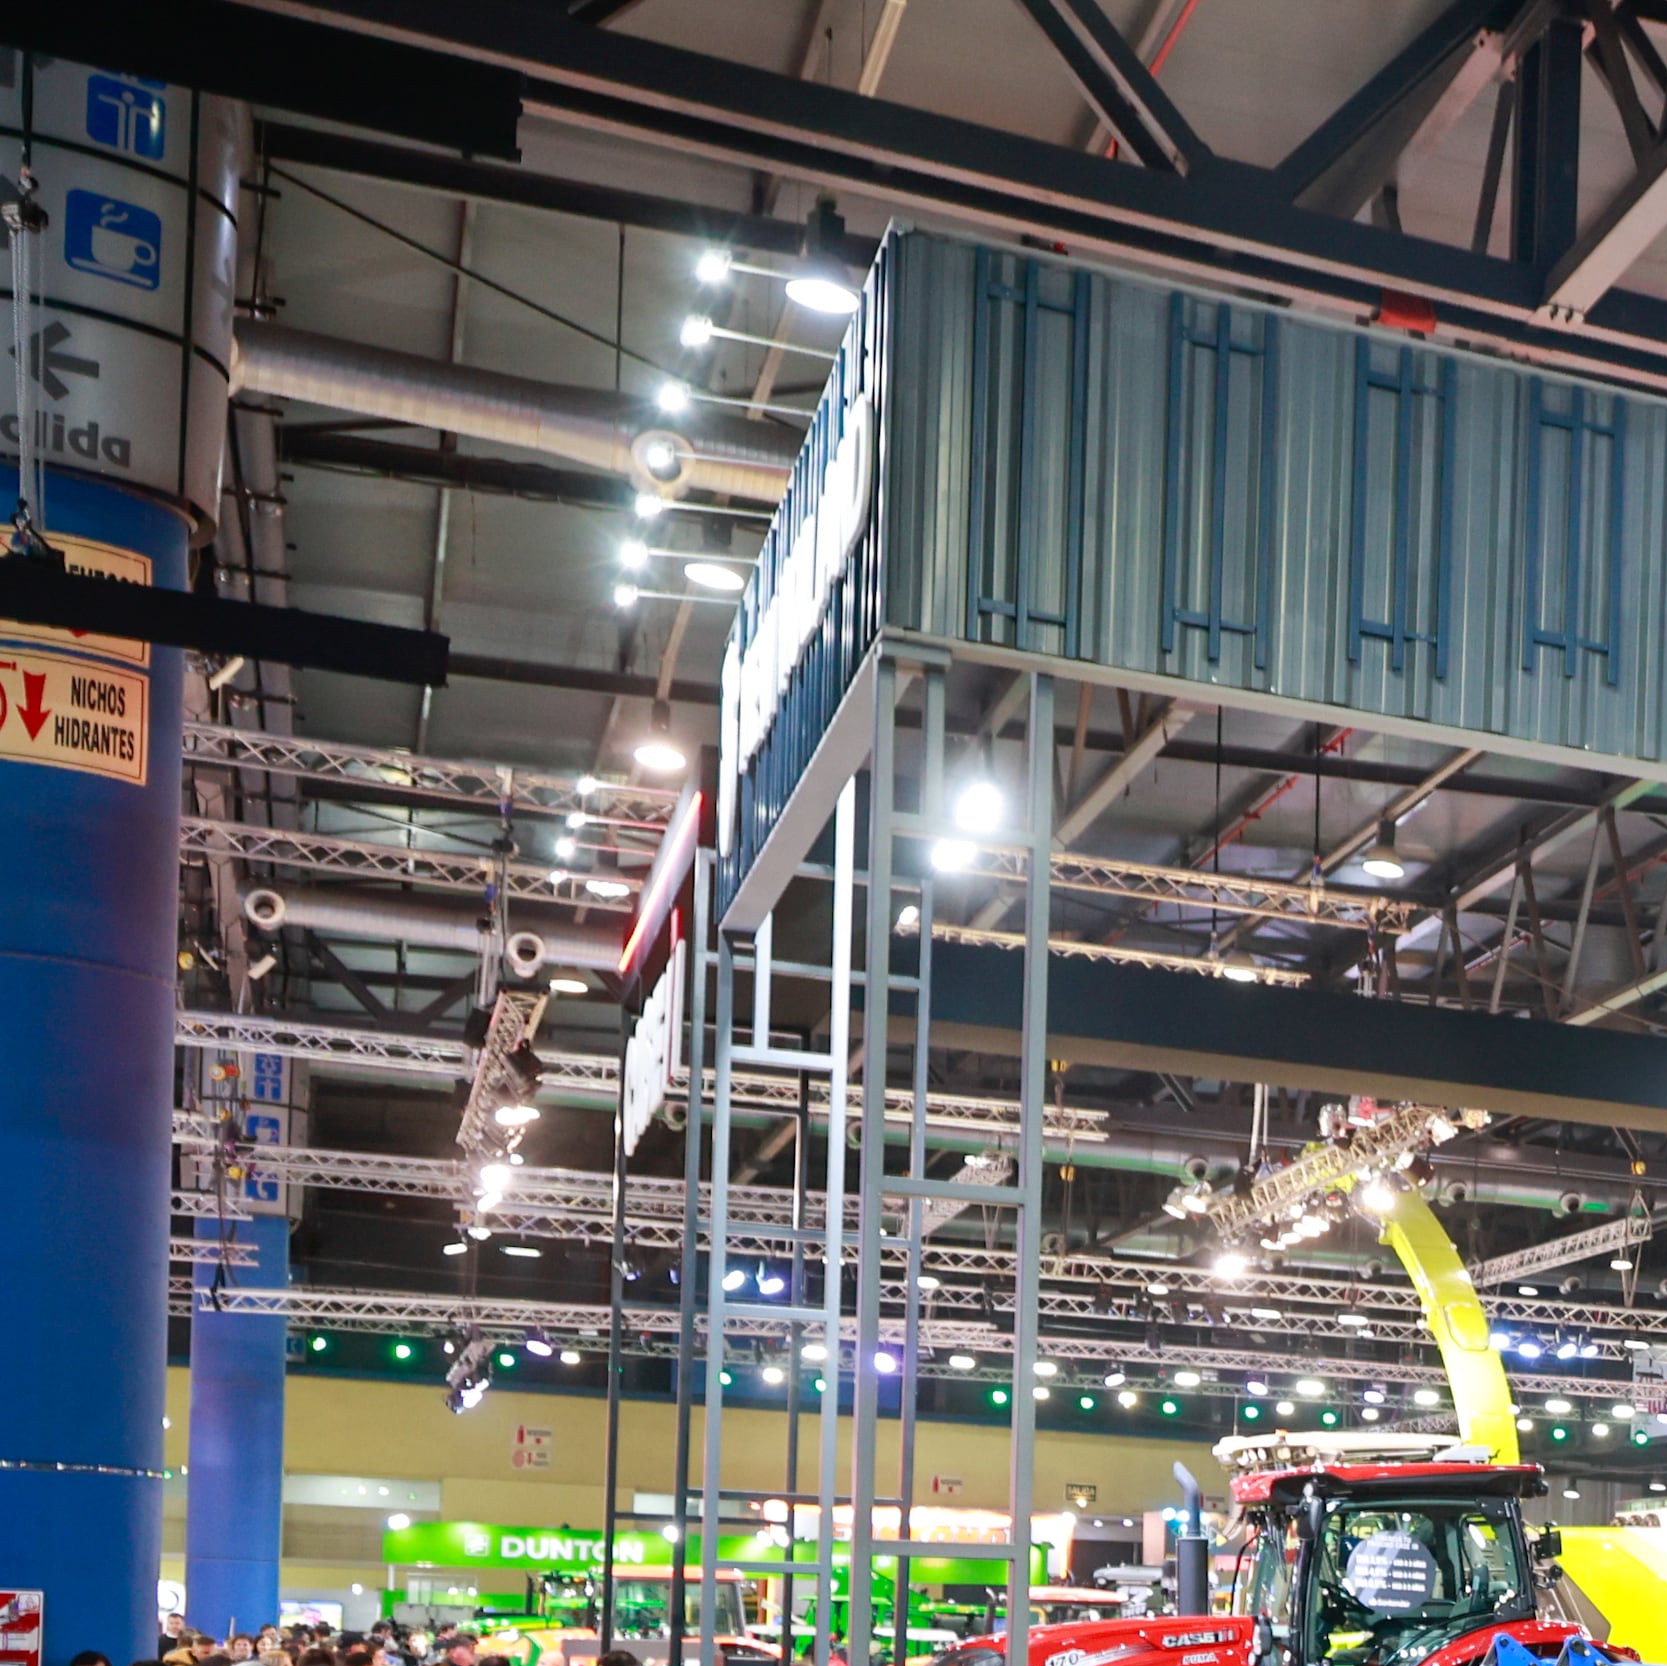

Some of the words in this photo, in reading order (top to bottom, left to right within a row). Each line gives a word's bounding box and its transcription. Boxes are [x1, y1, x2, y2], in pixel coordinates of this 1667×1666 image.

[71, 675, 126, 718] NICHOS
[54, 715, 135, 761] HIDRANTES
[500, 1535, 644, 1563] DUNTON
[1162, 1632, 1215, 1648] CASE
